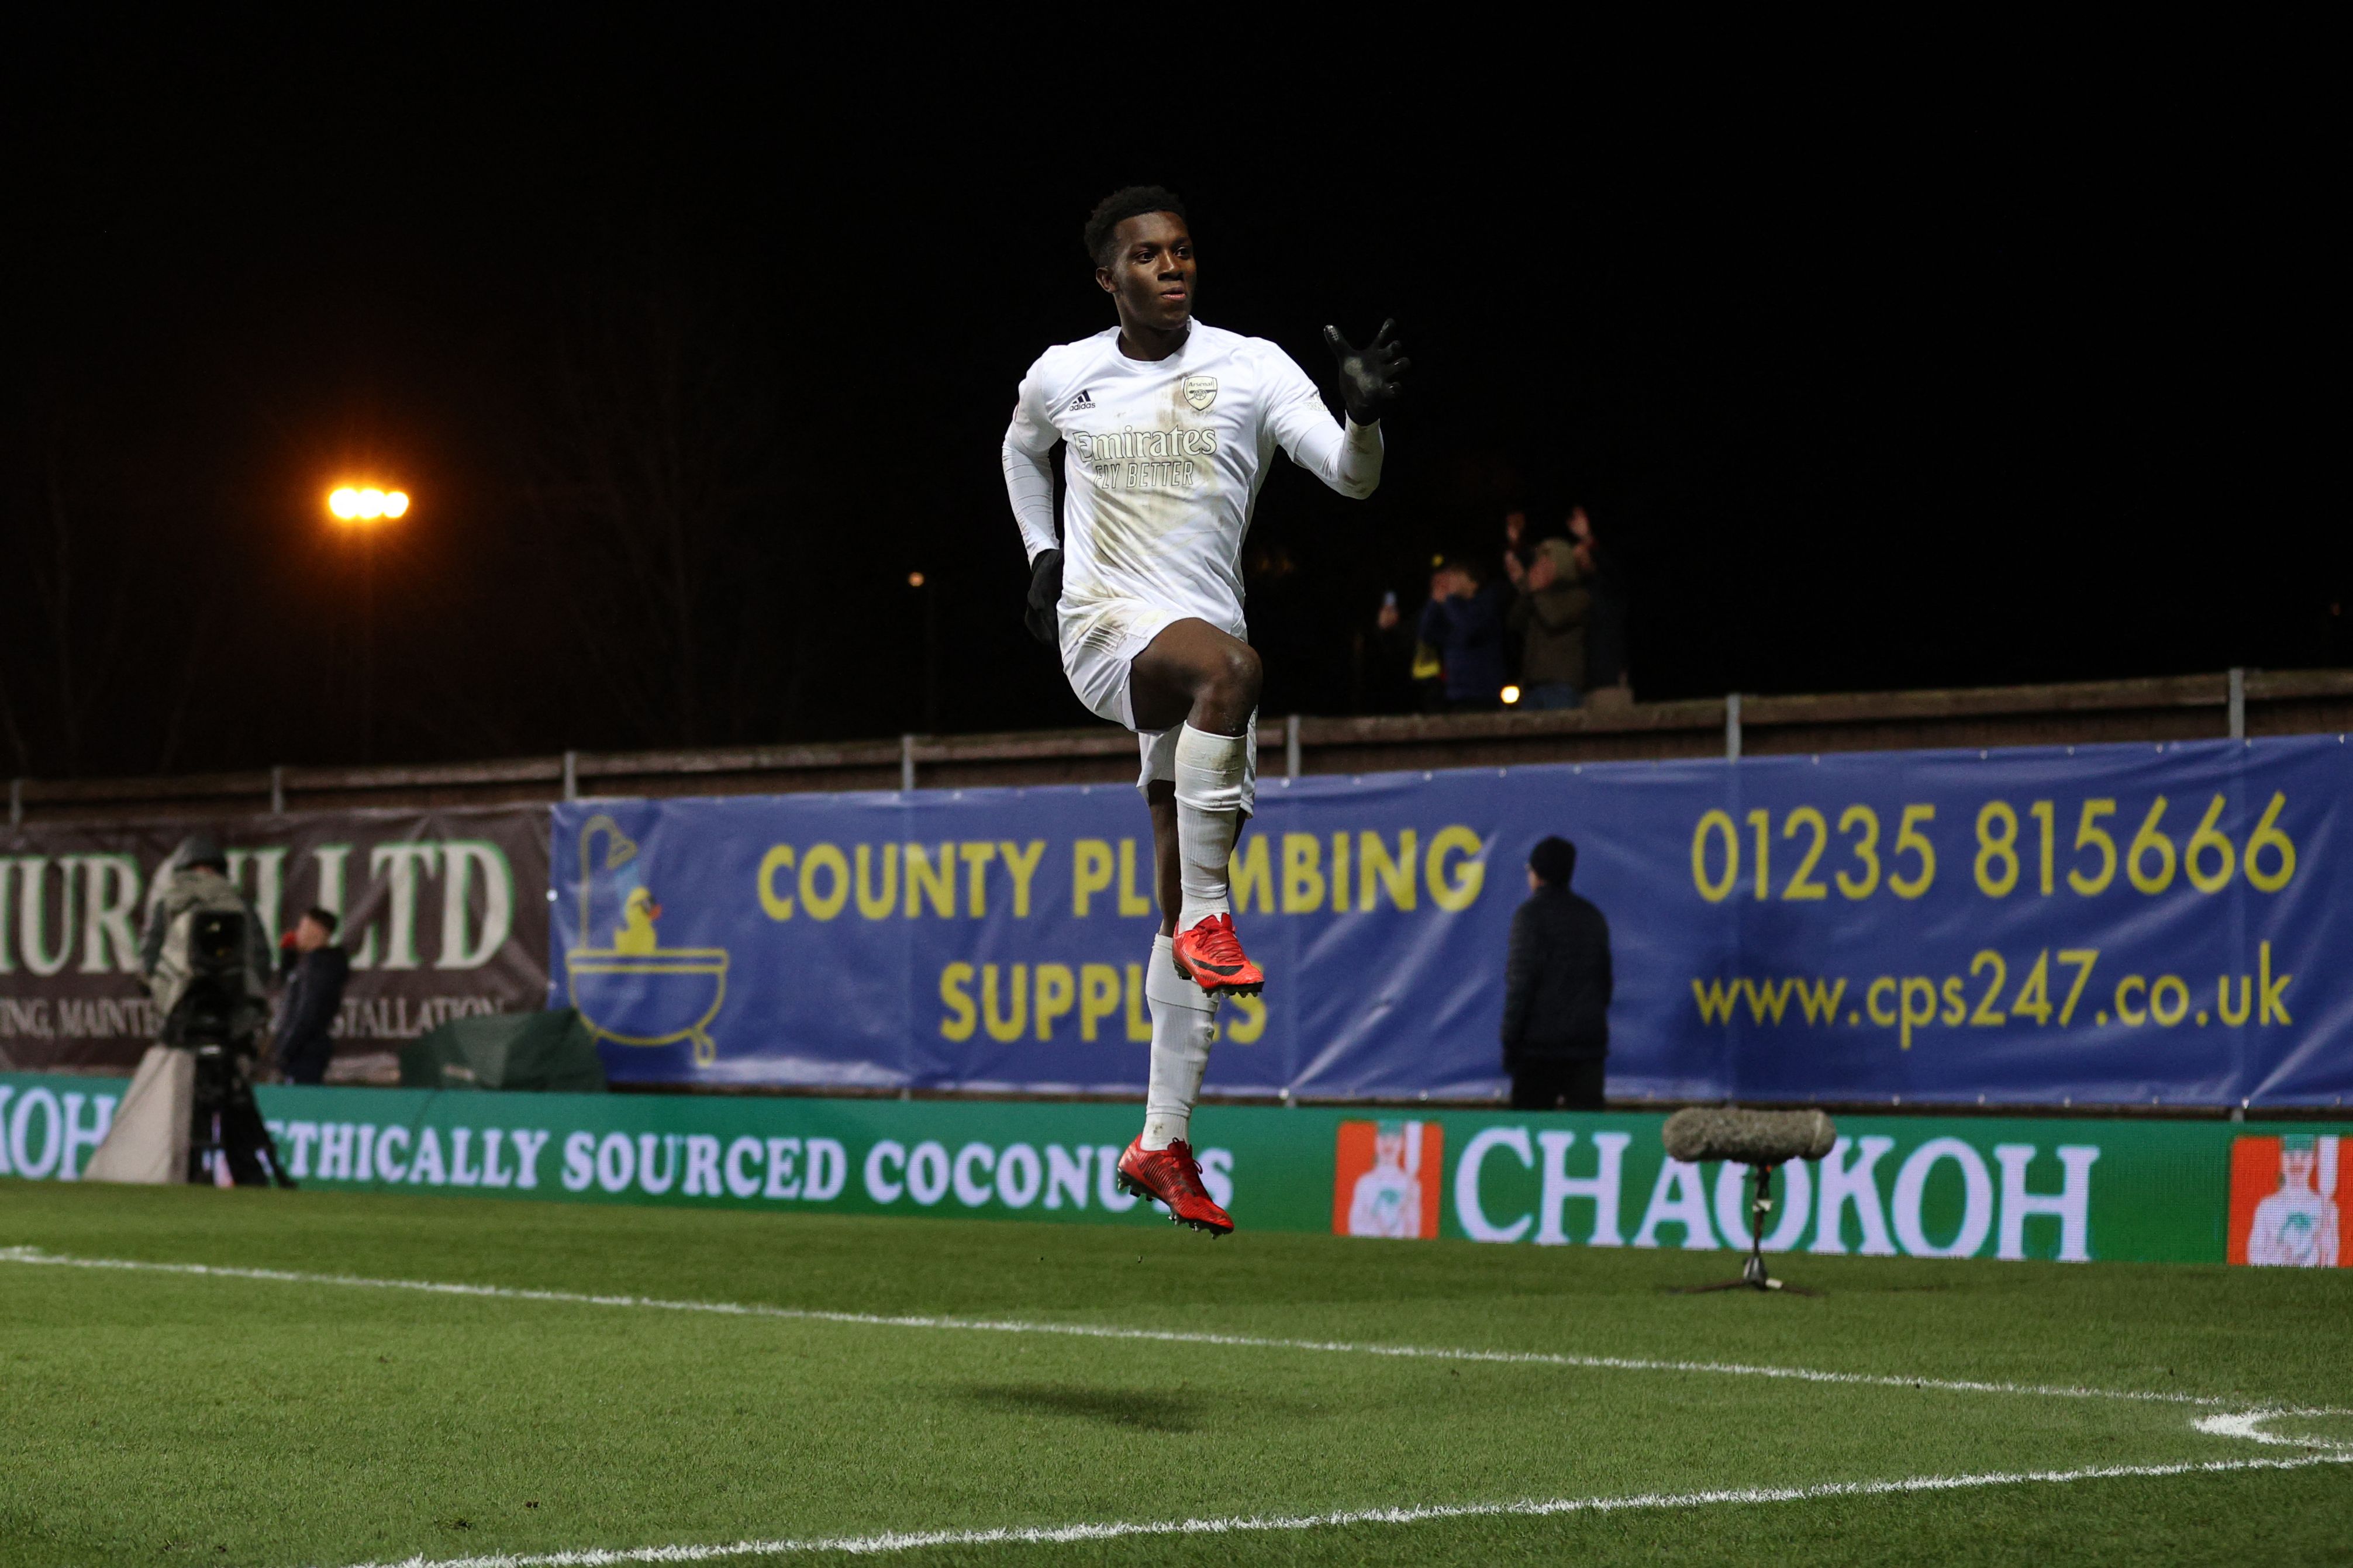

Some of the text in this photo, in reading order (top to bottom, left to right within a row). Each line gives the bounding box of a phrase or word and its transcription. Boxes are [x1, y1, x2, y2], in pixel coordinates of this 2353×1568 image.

[1069, 402, 1096, 412] adidas
[1072, 425, 1217, 463] Emirates
[1093, 461, 1194, 489] FLY BETTER
[757, 824, 1486, 921] COUNTY PLMBING
[1690, 792, 2296, 902] 01235 815666
[313, 839, 516, 971] LTD
[940, 961, 1268, 1044] SUPPLS
[1690, 940, 2293, 1050] www.cps247.co.uk
[561, 1130, 848, 1201] SOURCED
[864, 1139, 1235, 1213] COCONUS
[1454, 1125, 2101, 1263] CHAOKOH
